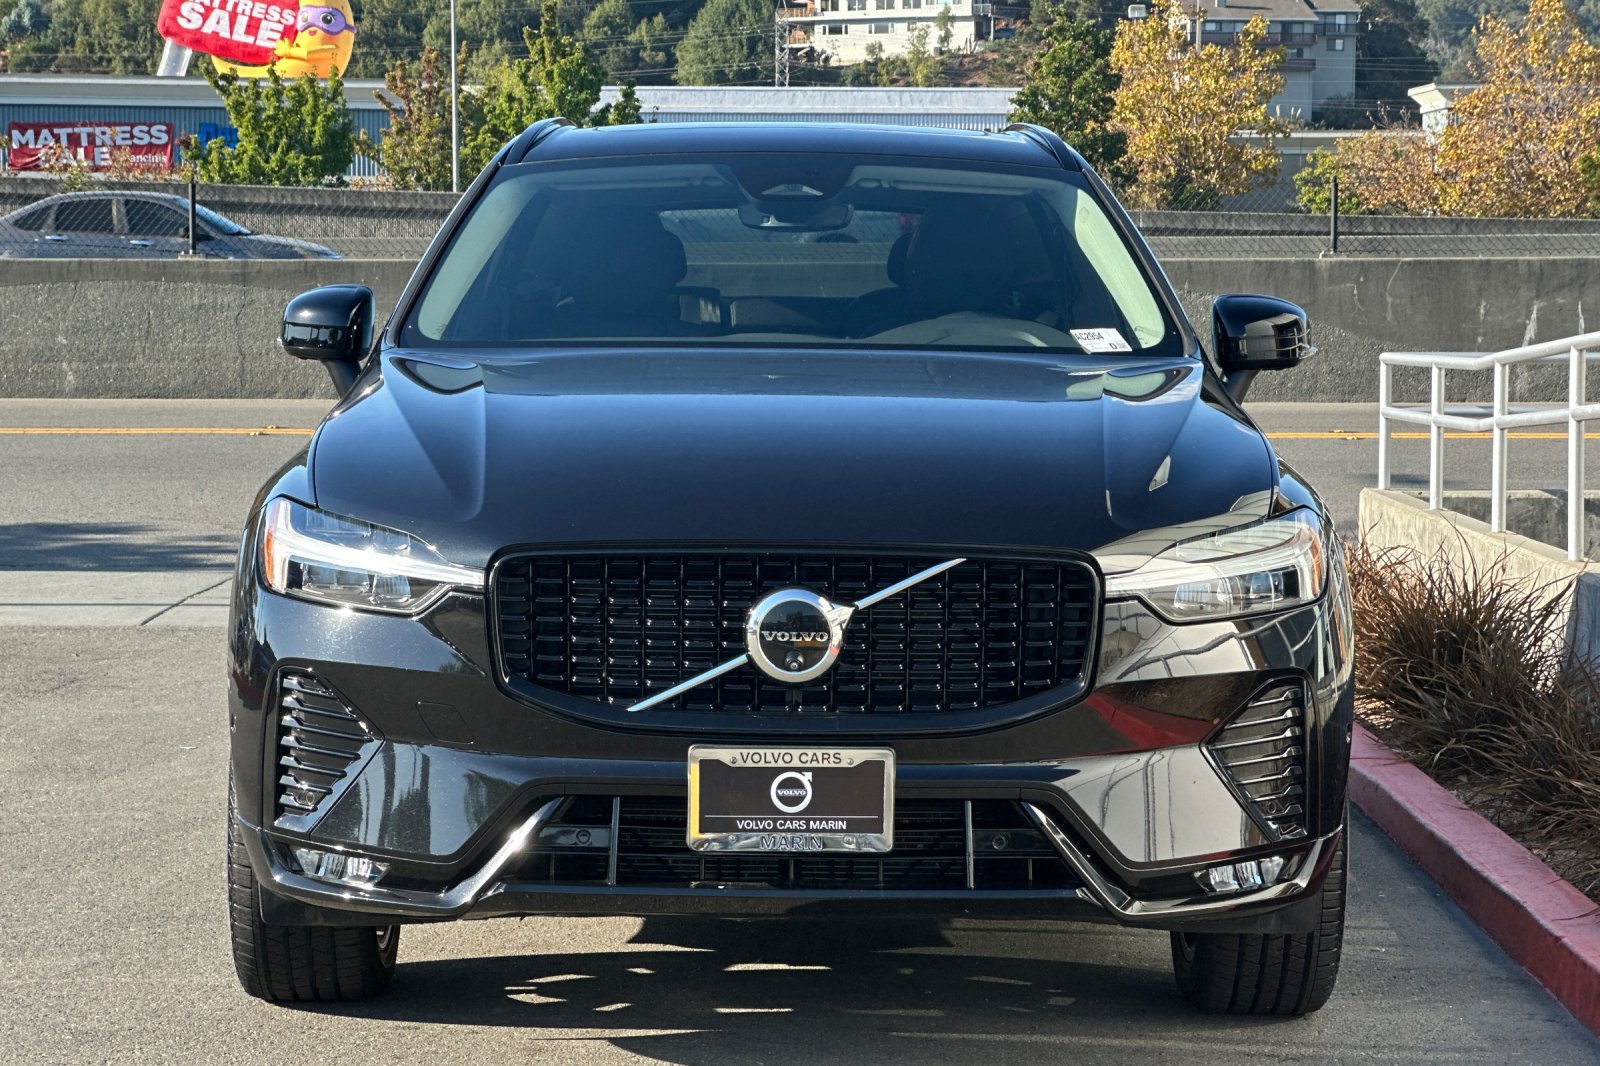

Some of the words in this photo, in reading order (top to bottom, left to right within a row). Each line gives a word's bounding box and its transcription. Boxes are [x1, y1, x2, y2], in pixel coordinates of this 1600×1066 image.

[189, 0, 296, 25] TRESS
[176, 1, 285, 48] SALE
[11, 124, 169, 148] MATTRESS
[761, 631, 829, 642] VOLVO
[740, 752, 793, 765] VOLVO
[798, 752, 842, 765] CARS
[736, 820, 774, 830] VOLVO
[776, 820, 807, 830] CARS
[809, 820, 847, 830] MARIN
[759, 835, 824, 850] MARIN
